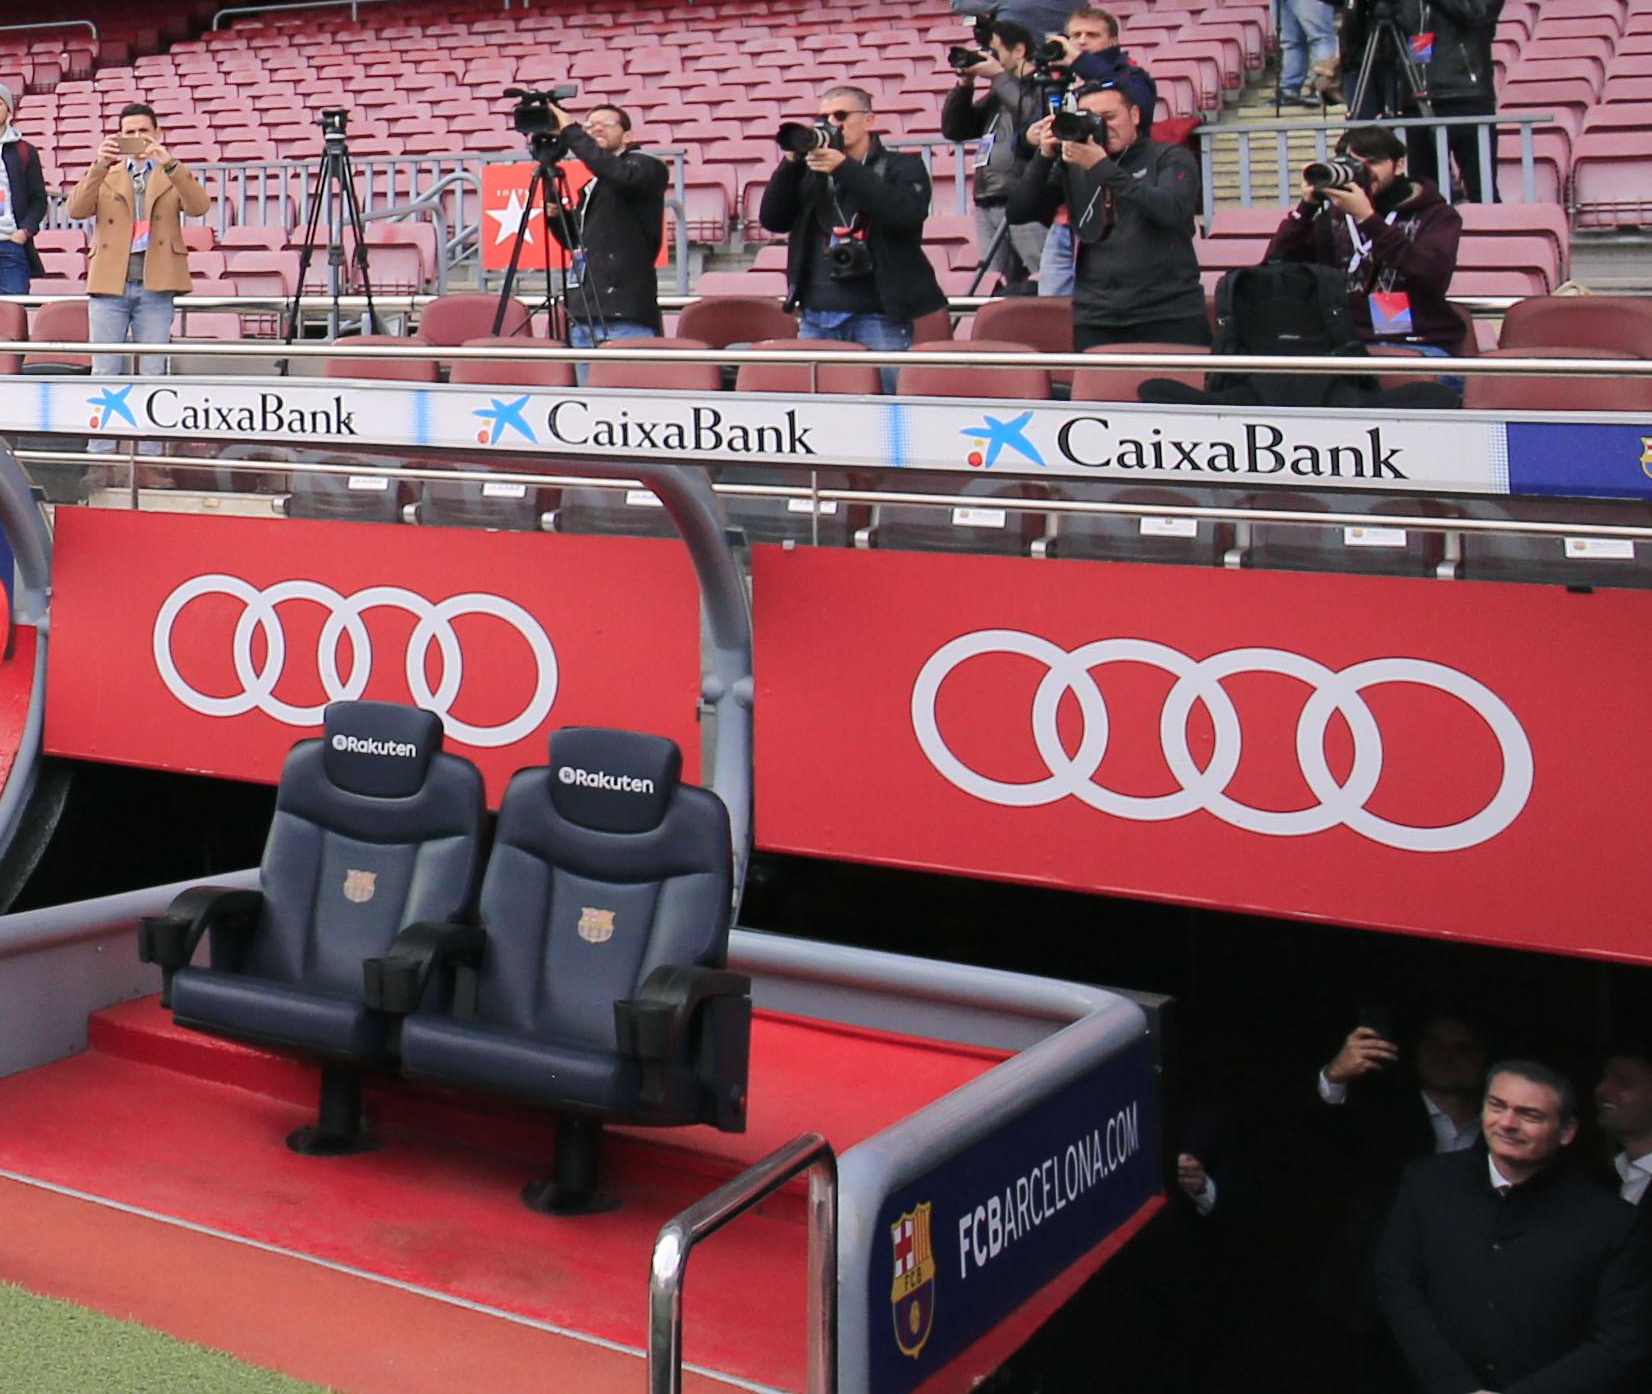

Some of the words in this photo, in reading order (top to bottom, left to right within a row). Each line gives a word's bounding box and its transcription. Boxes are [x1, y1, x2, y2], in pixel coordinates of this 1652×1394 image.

[145, 389, 359, 435] CaixaBank
[546, 399, 818, 456] CaixaBank
[1057, 415, 1409, 480] CaixaBank
[347, 736, 417, 758] Rakuten
[574, 768, 655, 794] Rakuten
[958, 1100, 1139, 1280] FCBARCELONA.COM
[903, 1265, 923, 1292] FCB
